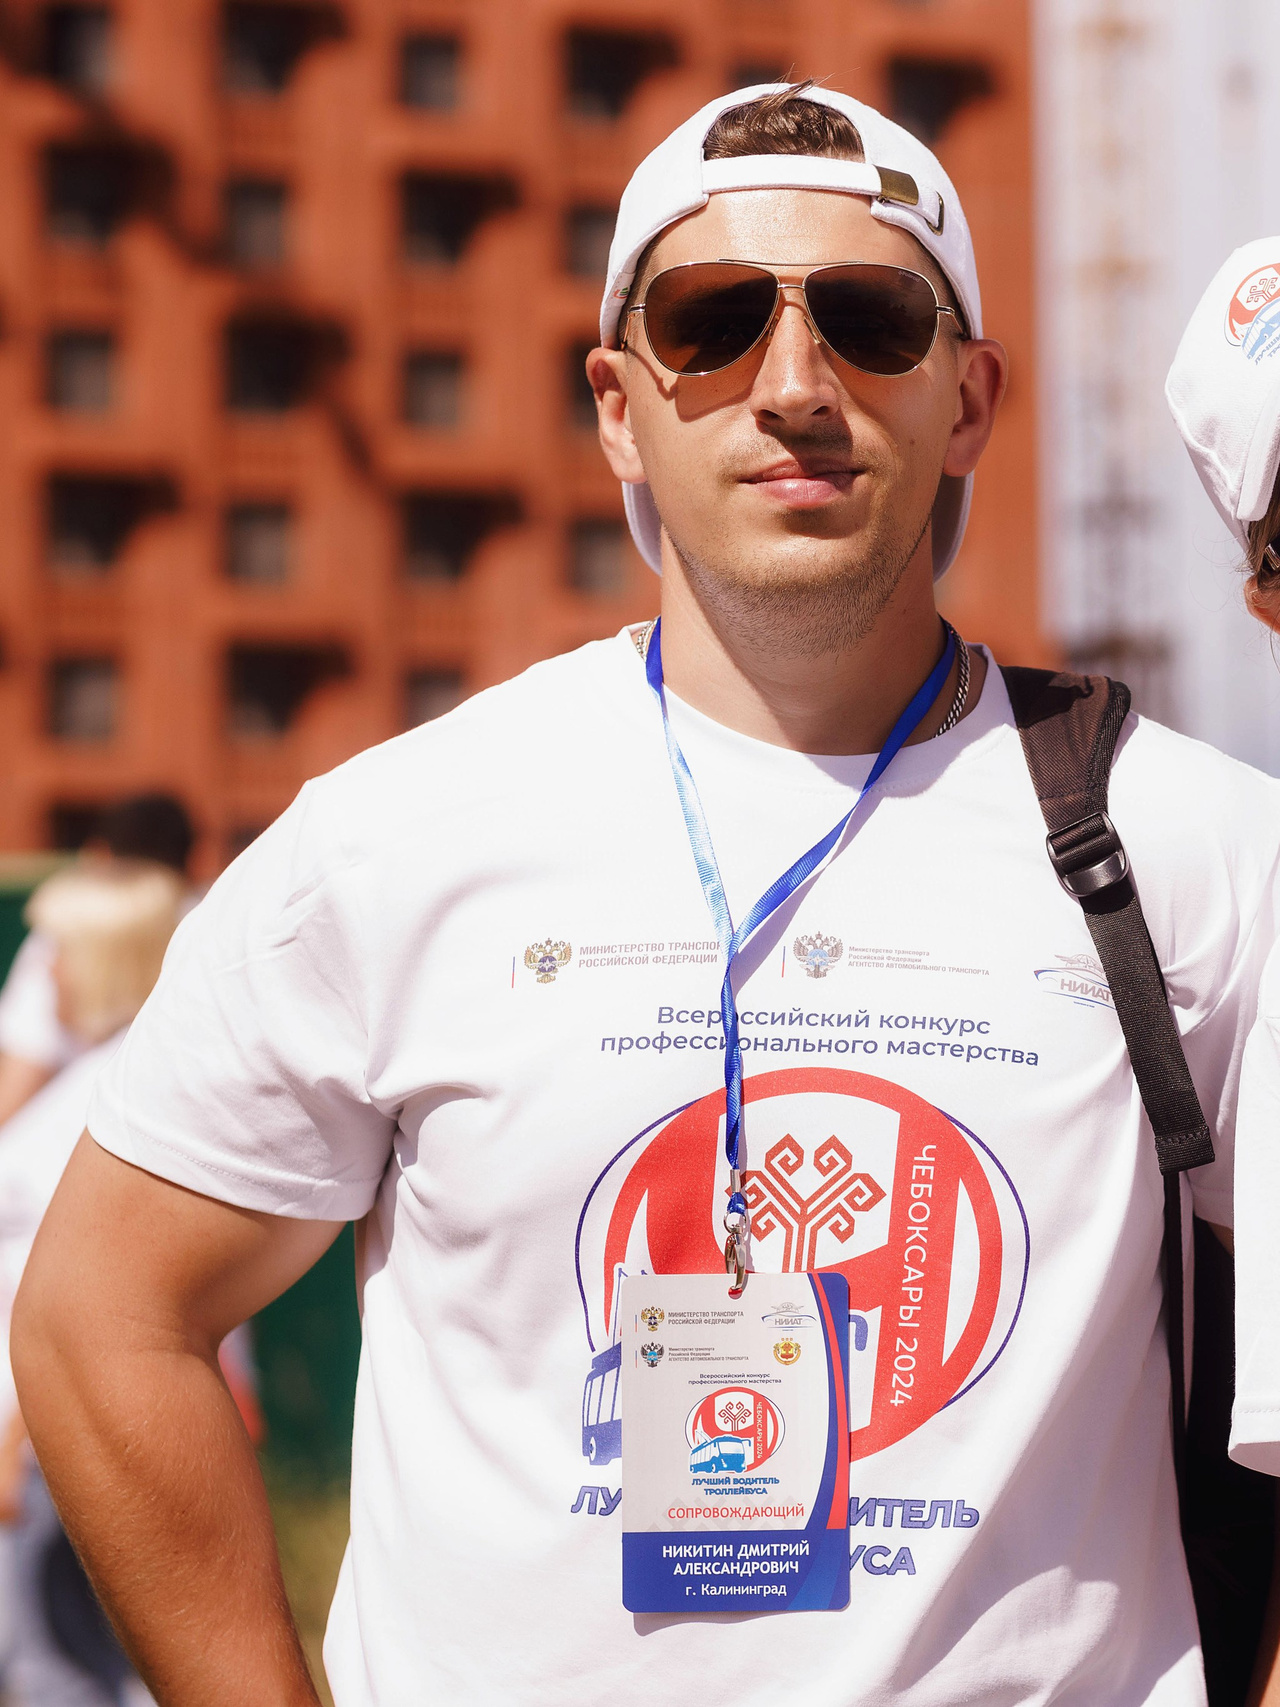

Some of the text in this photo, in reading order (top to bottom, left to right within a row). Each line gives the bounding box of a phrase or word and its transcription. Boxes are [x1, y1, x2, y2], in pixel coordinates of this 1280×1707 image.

[579, 941, 721, 955] МИНИСТЕРСТВО ТРАНСПО
[848, 946, 930, 957] Министерство транспорта
[578, 954, 718, 968] РОССИЙСКОЙ ФЕДЕРАЦИИ
[848, 953, 922, 963] Российской Федерации
[885, 962, 947, 972] АВТОМОБИЛЬНОГО
[948, 966, 990, 976] ТРАНСПОРТА
[657, 1006, 991, 1036] Всерссийский конкурс
[886, 1040, 1039, 1066] мастерства
[889, 1144, 937, 1407] ЧЕБОКСАРЫ 2024
[691, 1477, 780, 1486] ЛУЧШИЙ ВОДИТЕЛЬ
[704, 1487, 768, 1495] ТРОЛЛЕЙБУСА
[668, 1503, 805, 1520] СОПРОВОЖДАЮЩИЙ
[849, 1497, 980, 1529] ИТЕЛЬ
[662, 1540, 810, 1560] НИКИТИН ДМИТРИЙ
[673, 1561, 799, 1577] АЛЕКСАНДРОВИЧ
[685, 1583, 787, 1597] г. Калининград
